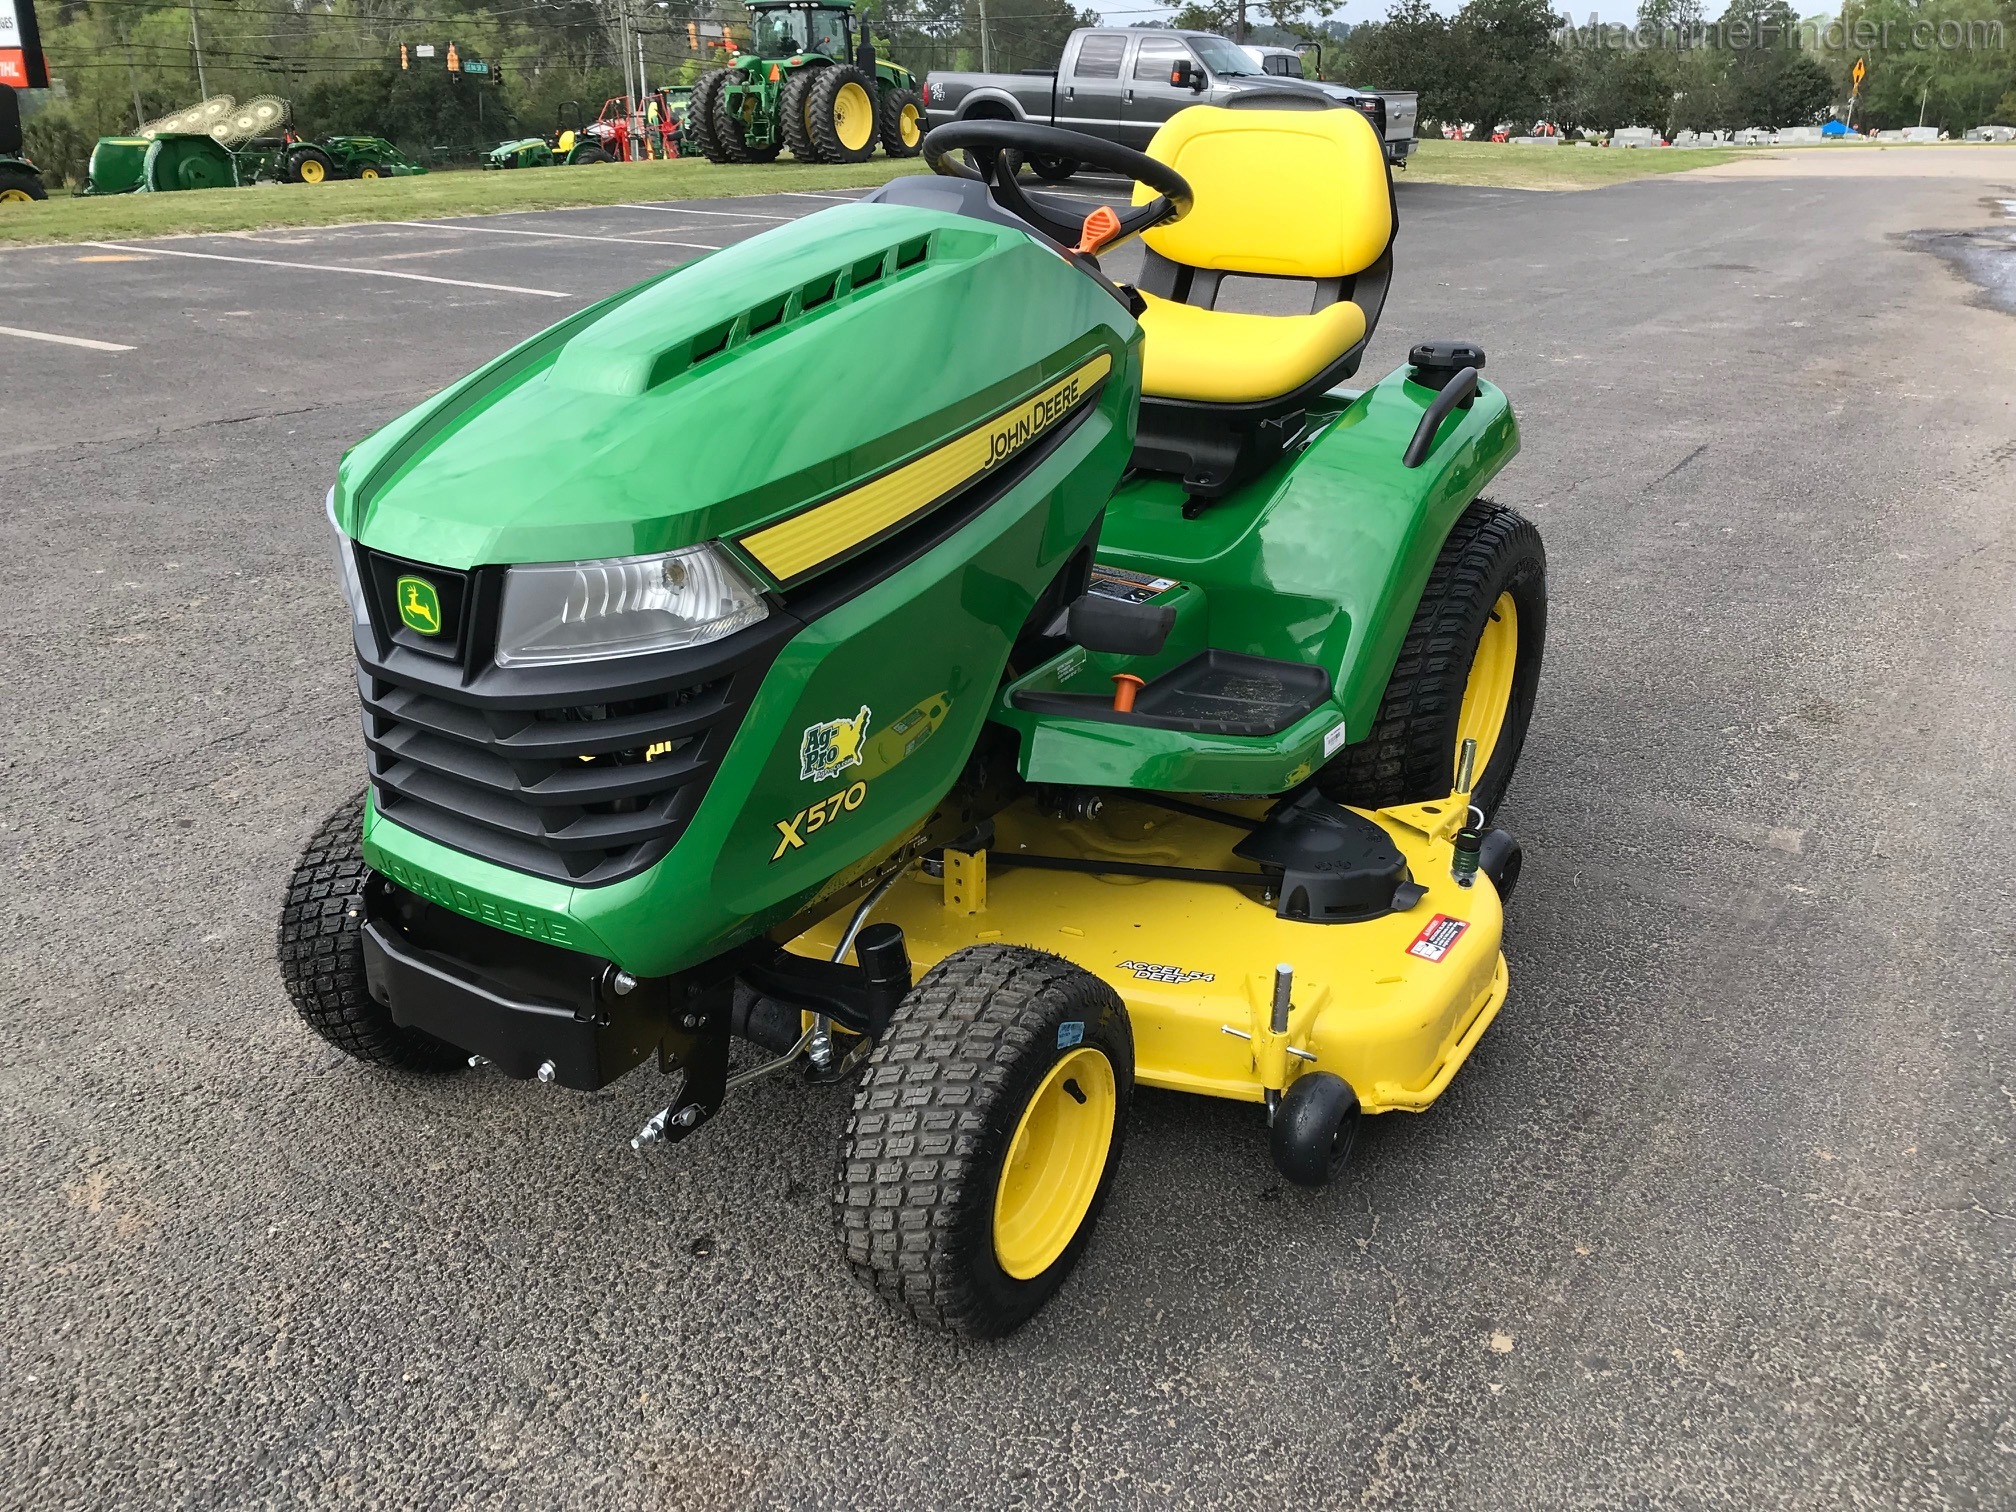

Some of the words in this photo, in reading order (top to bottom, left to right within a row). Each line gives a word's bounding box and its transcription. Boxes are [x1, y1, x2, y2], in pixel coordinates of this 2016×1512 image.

[984, 414, 1031, 468] JOHN
[1033, 377, 1080, 434] DEERE
[805, 727, 840, 755] Ag-
[803, 745, 840, 777] Pro
[767, 779, 867, 865] X570
[378, 849, 450, 906] JOHN
[448, 882, 573, 945] DEERE
[1115, 959, 1187, 978] ACCEL
[1187, 970, 1216, 983] 54
[1132, 969, 1191, 985] DEEP
